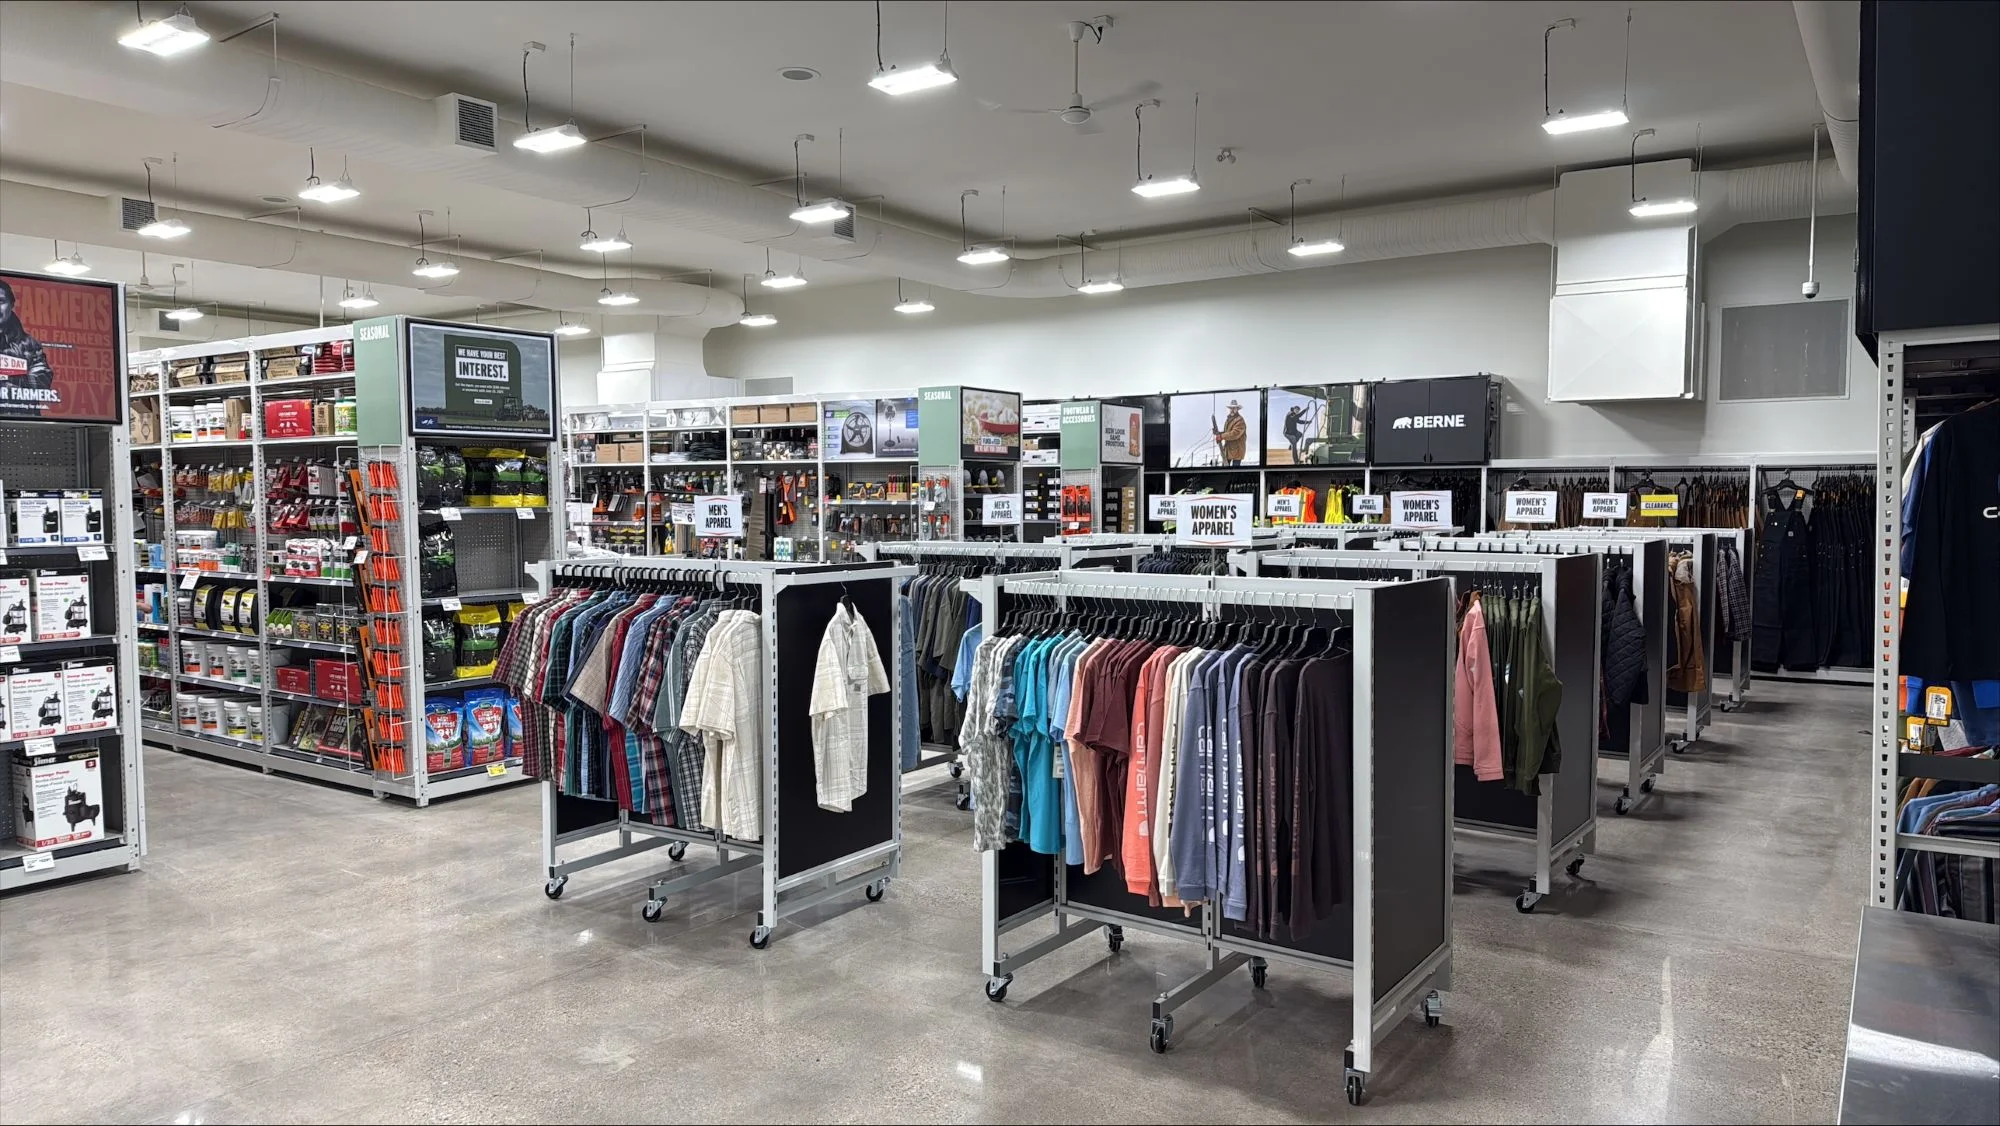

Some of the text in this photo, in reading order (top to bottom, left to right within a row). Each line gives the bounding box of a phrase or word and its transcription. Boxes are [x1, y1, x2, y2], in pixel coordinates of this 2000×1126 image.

[360, 324, 390, 341] SEASONAL
[458, 348, 506, 360] WE HAVE YOUR BEST
[11, 359, 25, 370] DAY
[459, 361, 506, 379] INTEREST.
[11, 387, 61, 402] FARMERS.
[924, 390, 952, 401] SEASONAL
[1063, 406, 1090, 416] FOOTWEAR
[1062, 414, 1096, 425] ACCESSORIES
[1413, 414, 1465, 429] BERNE
[994, 500, 1010, 510] MEN'S
[1402, 499, 1440, 511] WOMEN'S
[1516, 497, 1547, 506] WOMEN'S
[1592, 498, 1619, 506] WOMEN'S
[708, 504, 728, 516] MEN'S
[990, 510, 1013, 519] APPAREL
[1191, 505, 1237, 520] WOMEN'S
[1516, 506, 1545, 516] APPAREL
[1592, 505, 1617, 513] APPAREL
[1403, 511, 1439, 522] APPAREL
[705, 517, 732, 529] APPAREL
[1192, 521, 1235, 535] APPAREL
